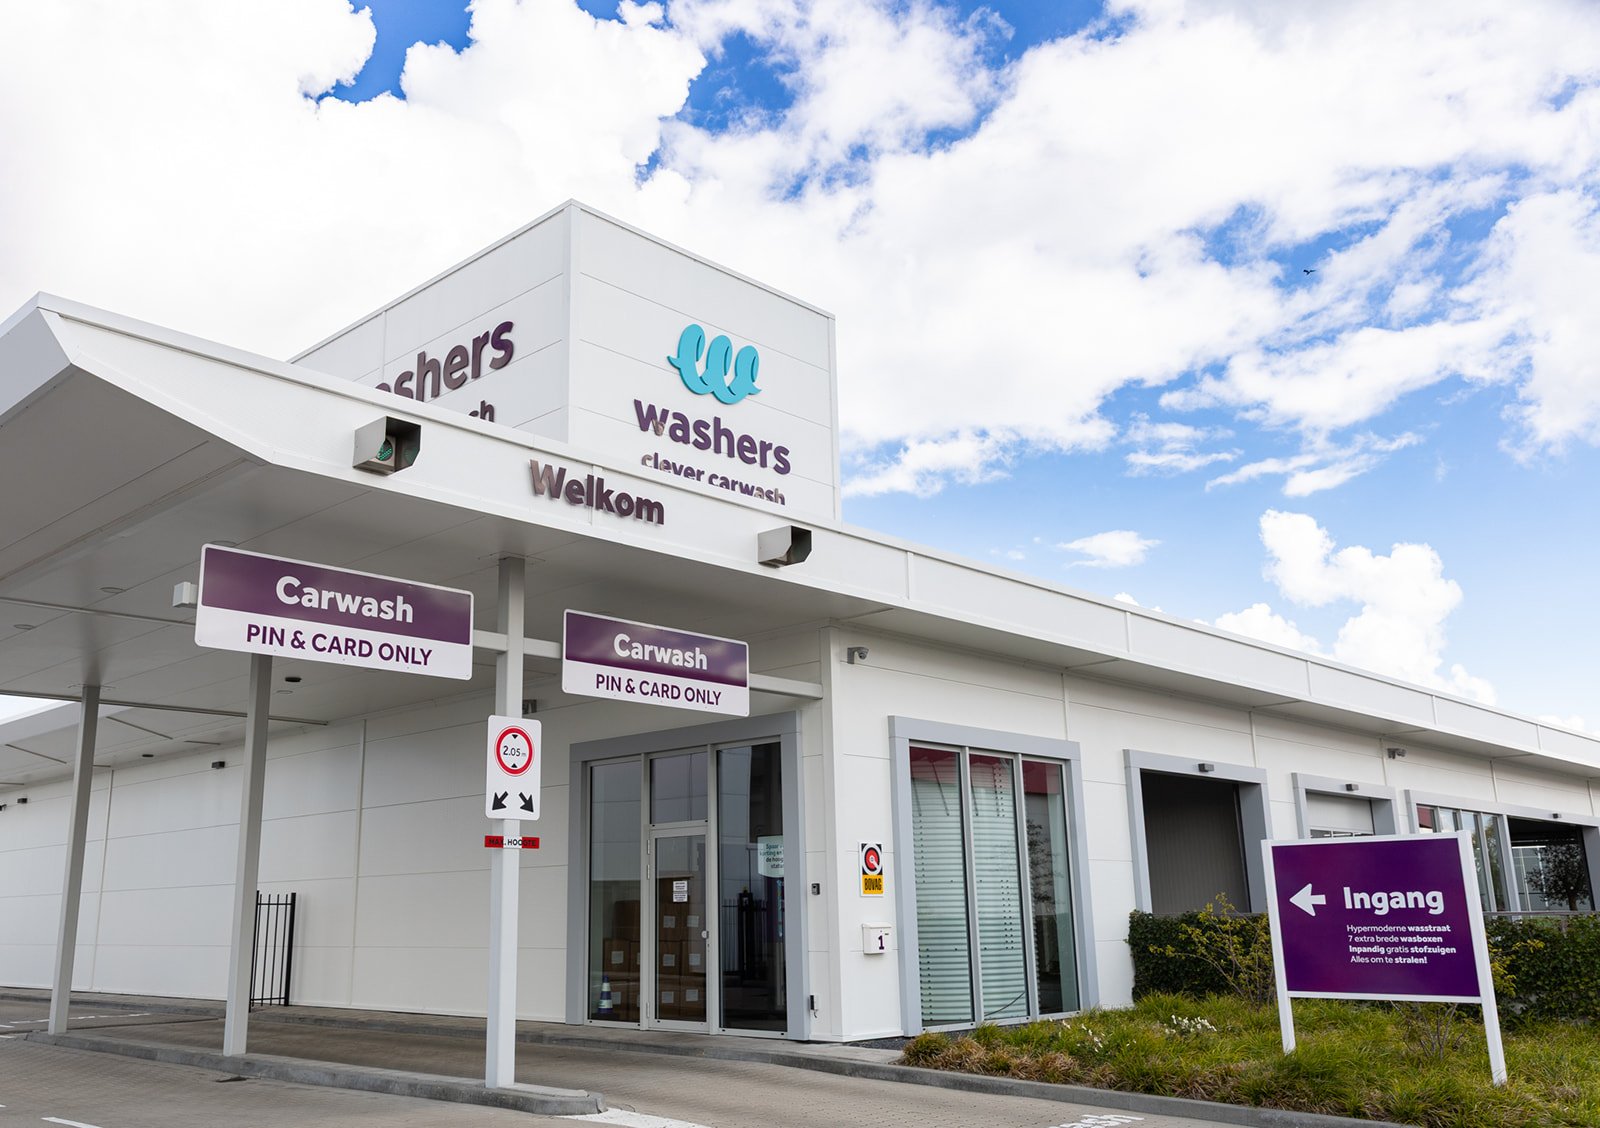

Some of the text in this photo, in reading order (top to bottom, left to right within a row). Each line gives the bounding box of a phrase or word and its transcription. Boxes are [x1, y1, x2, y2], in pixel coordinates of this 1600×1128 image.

[633, 399, 791, 475] washers
[641, 452, 786, 505] clever carwash
[529, 459, 665, 525] Welkom
[275, 575, 414, 624] Carwash
[246, 623, 433, 667] PIN & CARD ONLY
[613, 633, 708, 671] Carwash
[595, 673, 722, 707] PIN & CARD ONLY
[503, 745, 521, 757] 2.05
[507, 838, 537, 847] HOOGTE
[864, 877, 882, 891] BOVAG
[1343, 886, 1445, 915] Ingang
[1346, 924, 1451, 934] Hypermoderne wasstraat
[1400, 935, 1443, 943] wasboxen
[878, 935, 885, 950] 1
[1349, 945, 1456, 955] Inpandig gratis stofzuigen
[1350, 955, 1369, 963] Alles
[1394, 955, 1428, 964] stralen!
